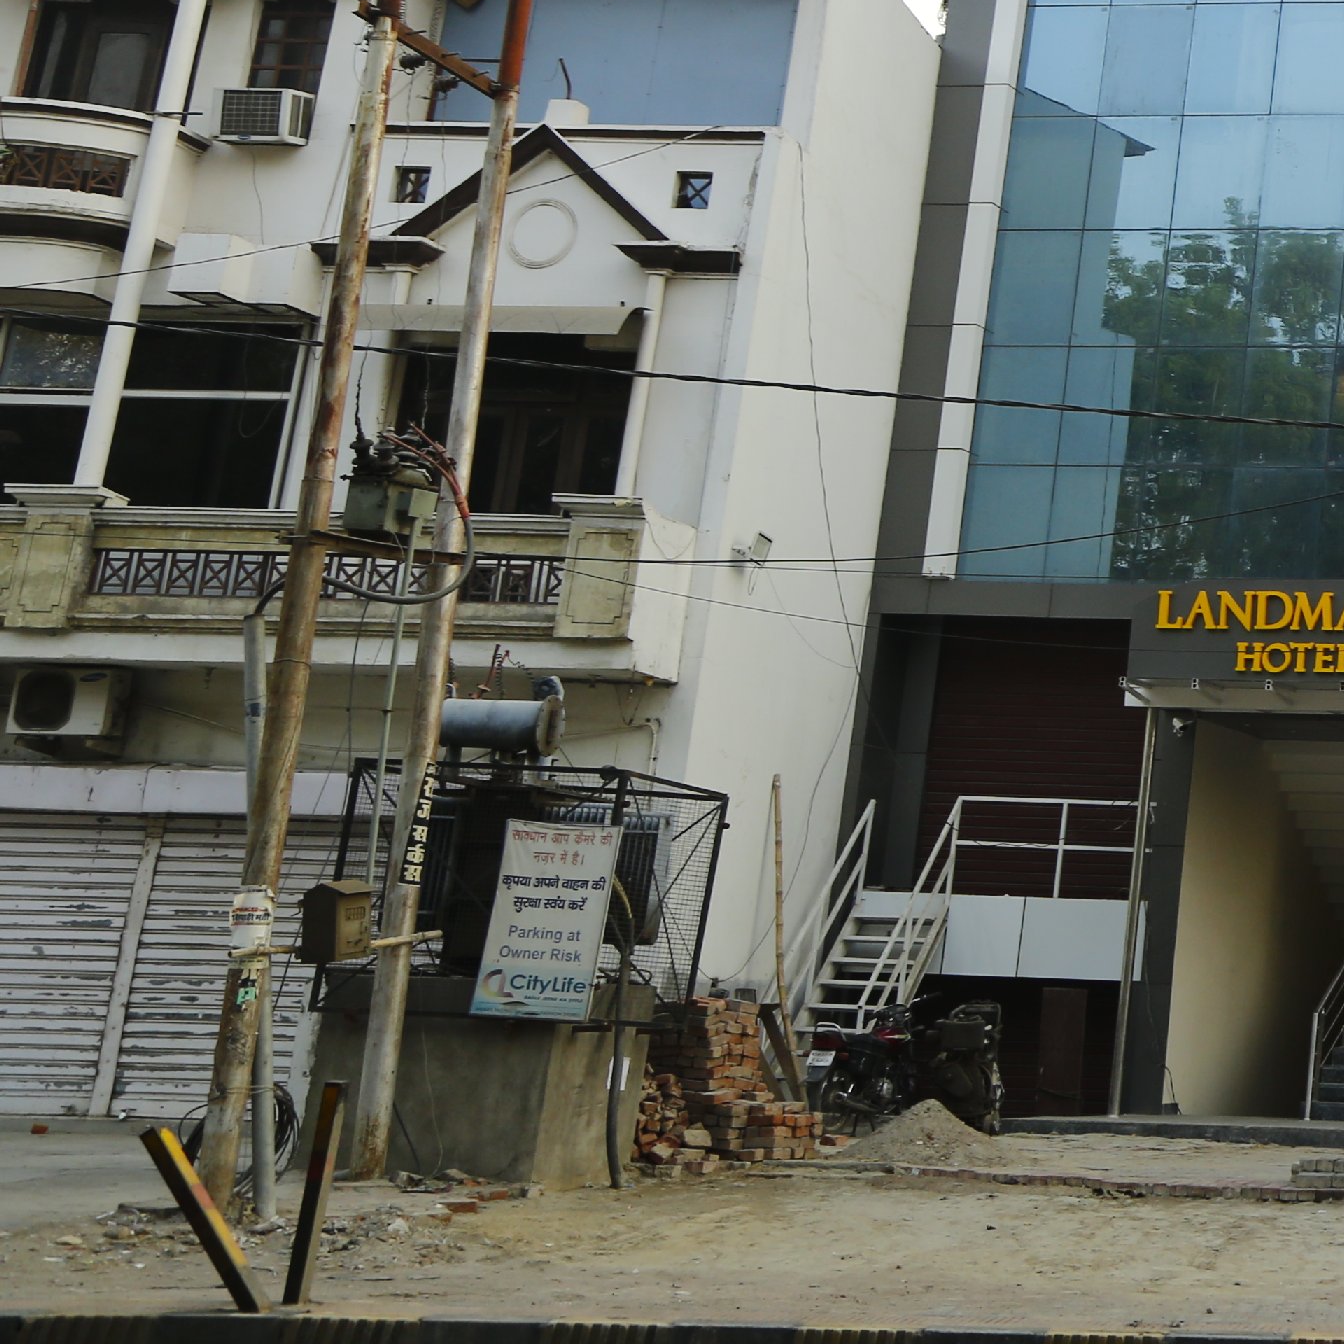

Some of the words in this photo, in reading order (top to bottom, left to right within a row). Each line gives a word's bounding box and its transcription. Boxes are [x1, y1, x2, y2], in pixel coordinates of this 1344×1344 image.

[551, 832, 570, 845] आप
[600, 831, 613, 846] की
[560, 849, 569, 865] में
[502, 874, 531, 891] कृपया
[533, 874, 560, 889] अपने
[562, 878, 590, 891] वाहन
[591, 876, 607, 891] की
[513, 896, 542, 913] सुरक्षा
[567, 896, 589, 911] करें
[508, 925, 563, 944] Parking
[566, 930, 582, 942] at
[499, 945, 546, 960] Owner
[550, 948, 582, 963] Risk
[509, 974, 587, 995] CityLife
